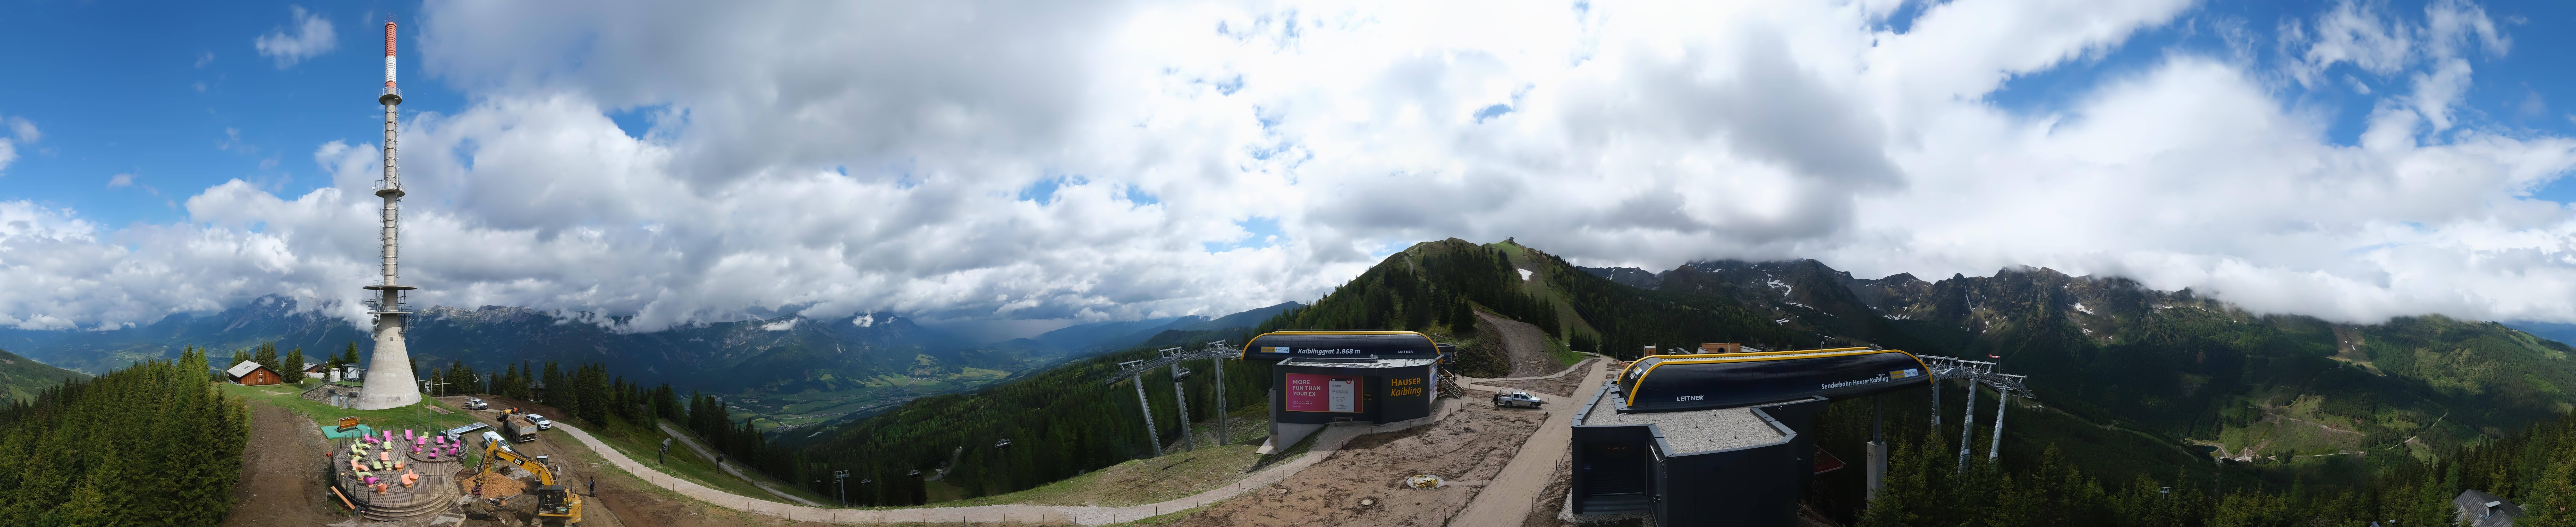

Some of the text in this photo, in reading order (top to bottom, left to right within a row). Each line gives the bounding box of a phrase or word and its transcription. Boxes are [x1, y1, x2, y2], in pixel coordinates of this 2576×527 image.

[1391, 378, 1421, 387] HAUSER
[1821, 380, 1852, 389] Senderbahn
[1391, 386, 1421, 397] Kaibling
